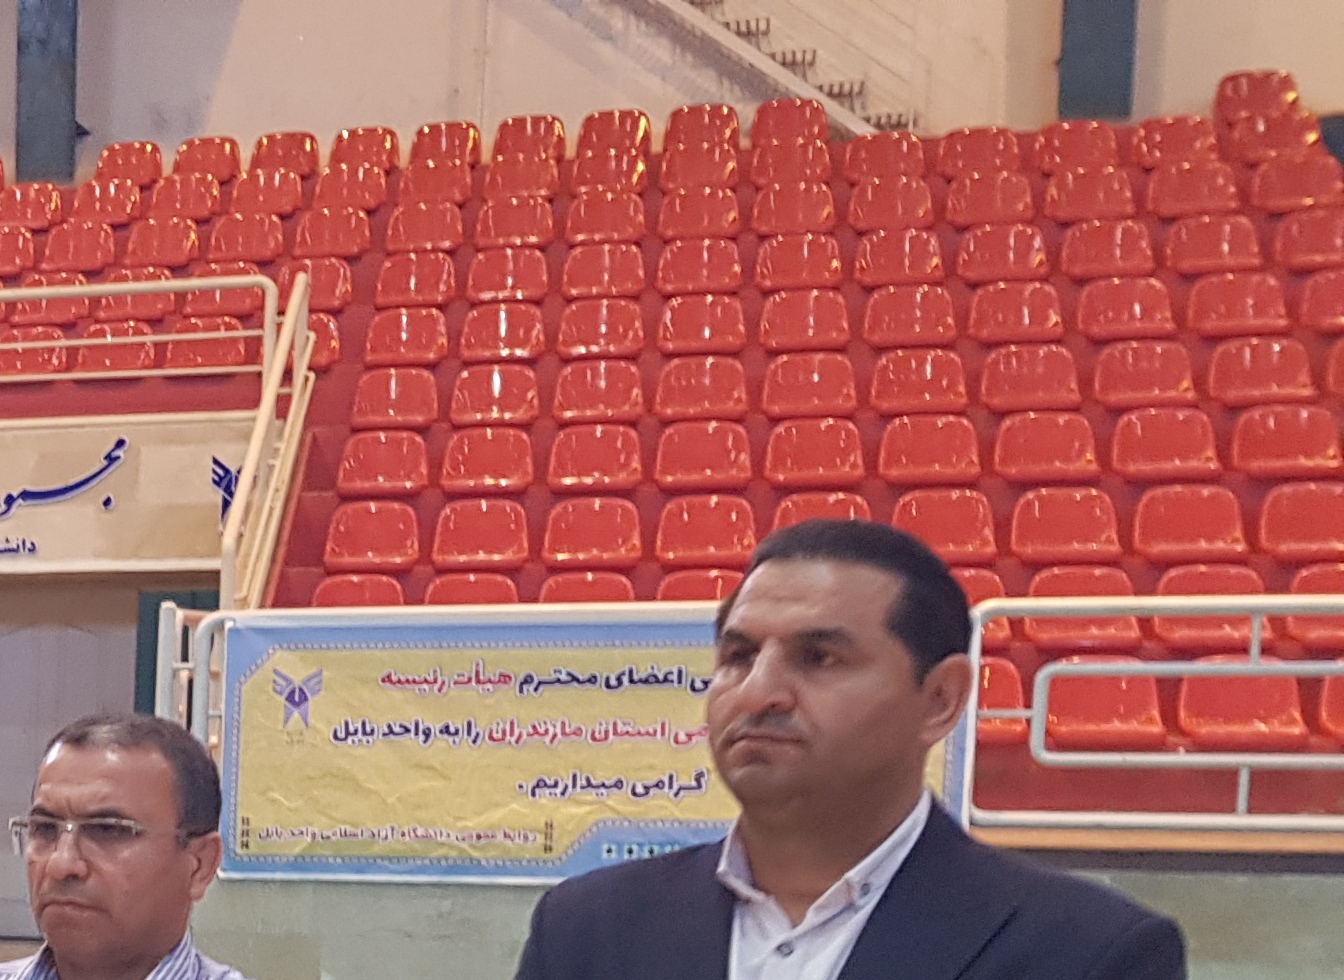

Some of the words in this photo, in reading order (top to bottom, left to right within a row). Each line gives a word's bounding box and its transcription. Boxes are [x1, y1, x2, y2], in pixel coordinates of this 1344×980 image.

[518, 667, 599, 695] محترم
[603, 664, 683, 690] اعضای
[331, 718, 375, 745] بابل
[381, 718, 432, 744] واحد
[487, 718, 584, 745] مازندران
[590, 719, 666, 743] استان
[630, 768, 706, 798] گرامی
